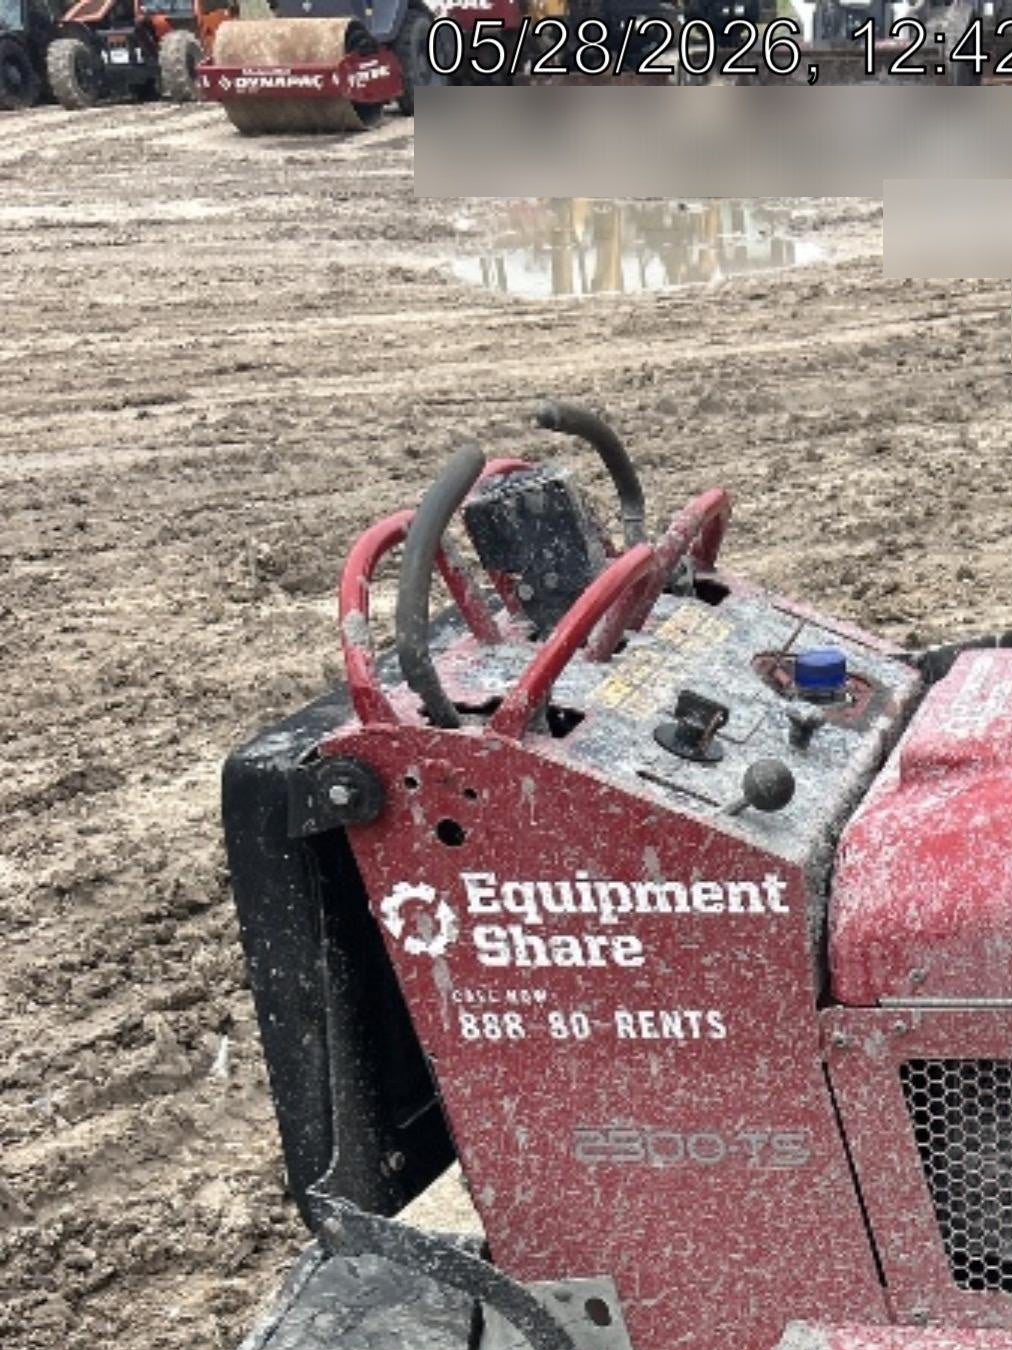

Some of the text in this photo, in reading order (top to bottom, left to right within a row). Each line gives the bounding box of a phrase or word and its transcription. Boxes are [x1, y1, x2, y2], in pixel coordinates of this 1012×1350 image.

[235, 74, 325, 90] DYNAPAC
[459, 870, 790, 924] Equipment
[471, 924, 646, 968] Share
